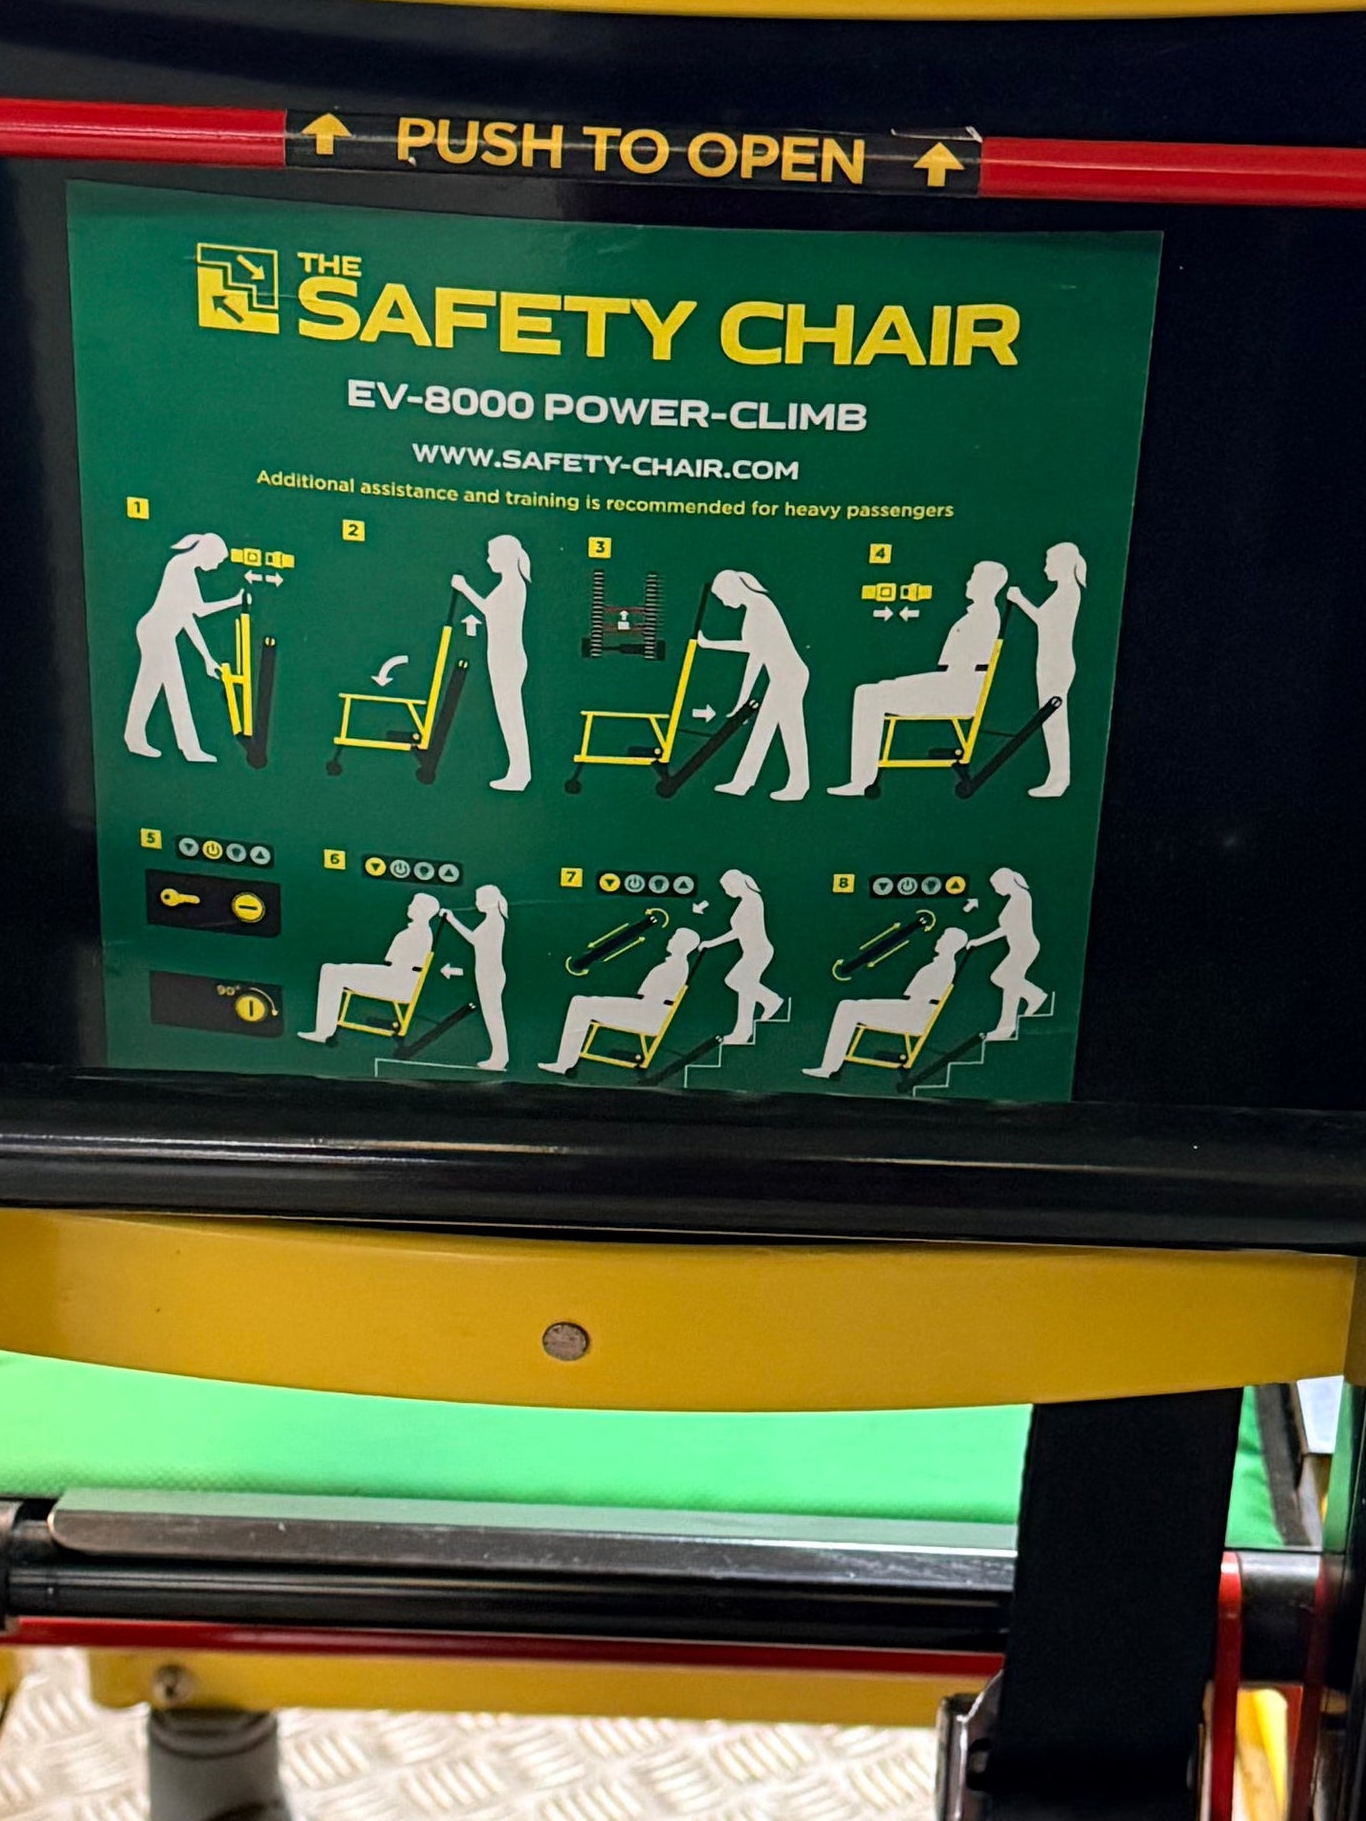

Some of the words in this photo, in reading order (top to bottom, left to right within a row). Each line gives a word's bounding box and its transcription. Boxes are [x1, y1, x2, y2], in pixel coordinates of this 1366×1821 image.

[397, 116, 564, 169] PUSH
[583, 126, 668, 174] TO
[688, 131, 865, 185] OPEN
[297, 251, 362, 277] THE
[298, 276, 697, 360] SAFETY
[720, 301, 1020, 366] CHAIR
[348, 379, 535, 420] EV-8000
[544, 393, 867, 431] POWER-CLIMB
[412, 443, 799, 481] WWW.SAFETY-CHAIR.COM
[257, 469, 355, 494] Additional
[360, 480, 459, 502] assistance
[463, 490, 500, 505] and
[505, 491, 580, 511] training
[586, 495, 600, 511] is
[606, 497, 745, 516] recommended
[751, 500, 778, 517] for
[785, 501, 841, 520] heavy
[847, 504, 954, 521] passengers
